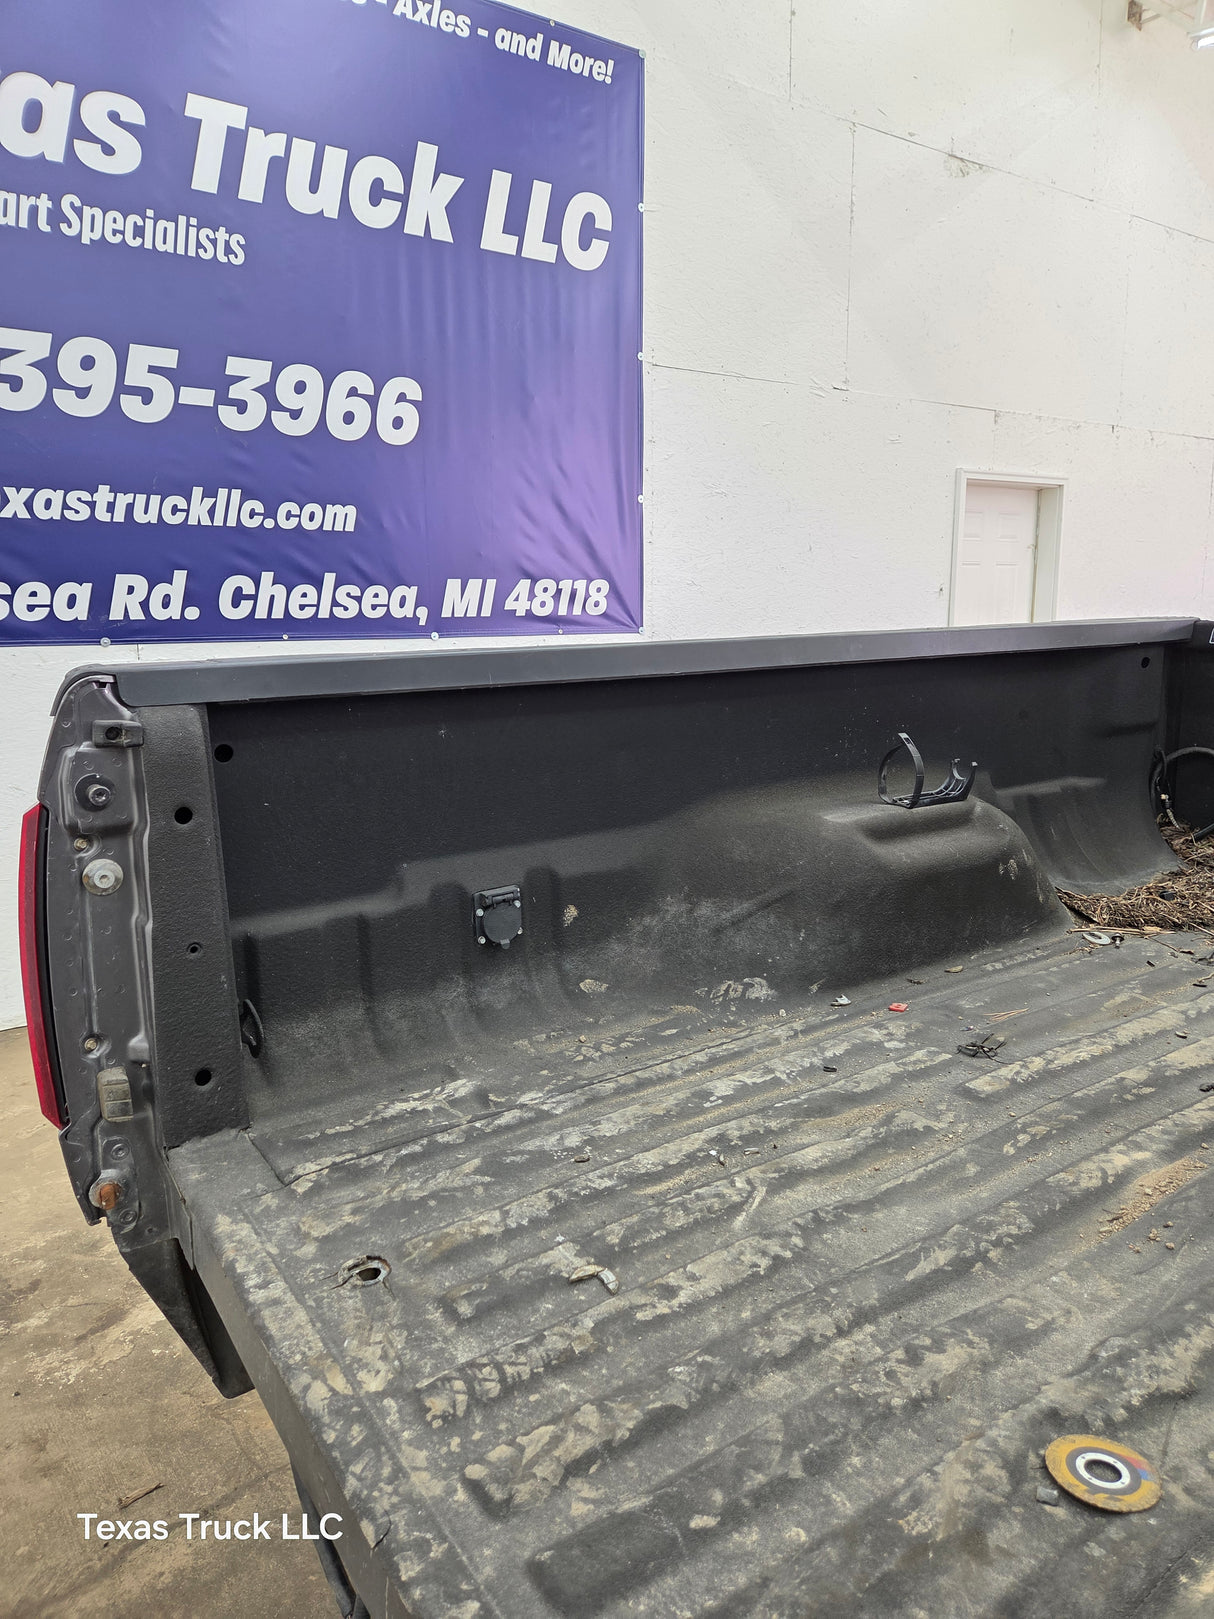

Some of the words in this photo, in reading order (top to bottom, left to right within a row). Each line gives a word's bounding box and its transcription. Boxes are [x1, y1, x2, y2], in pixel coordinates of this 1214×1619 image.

[494, 32, 544, 62] and
[547, 39, 615, 84] More!
[184, 92, 465, 244] Truck
[480, 169, 613, 271] LLC
[60, 193, 246, 266] Specialists
[0, 326, 423, 446] 395-3966
[109, 569, 200, 621] Rd.
[218, 571, 429, 626] Chelsea,
[441, 578, 497, 618] MI
[504, 578, 610, 617] 48118
